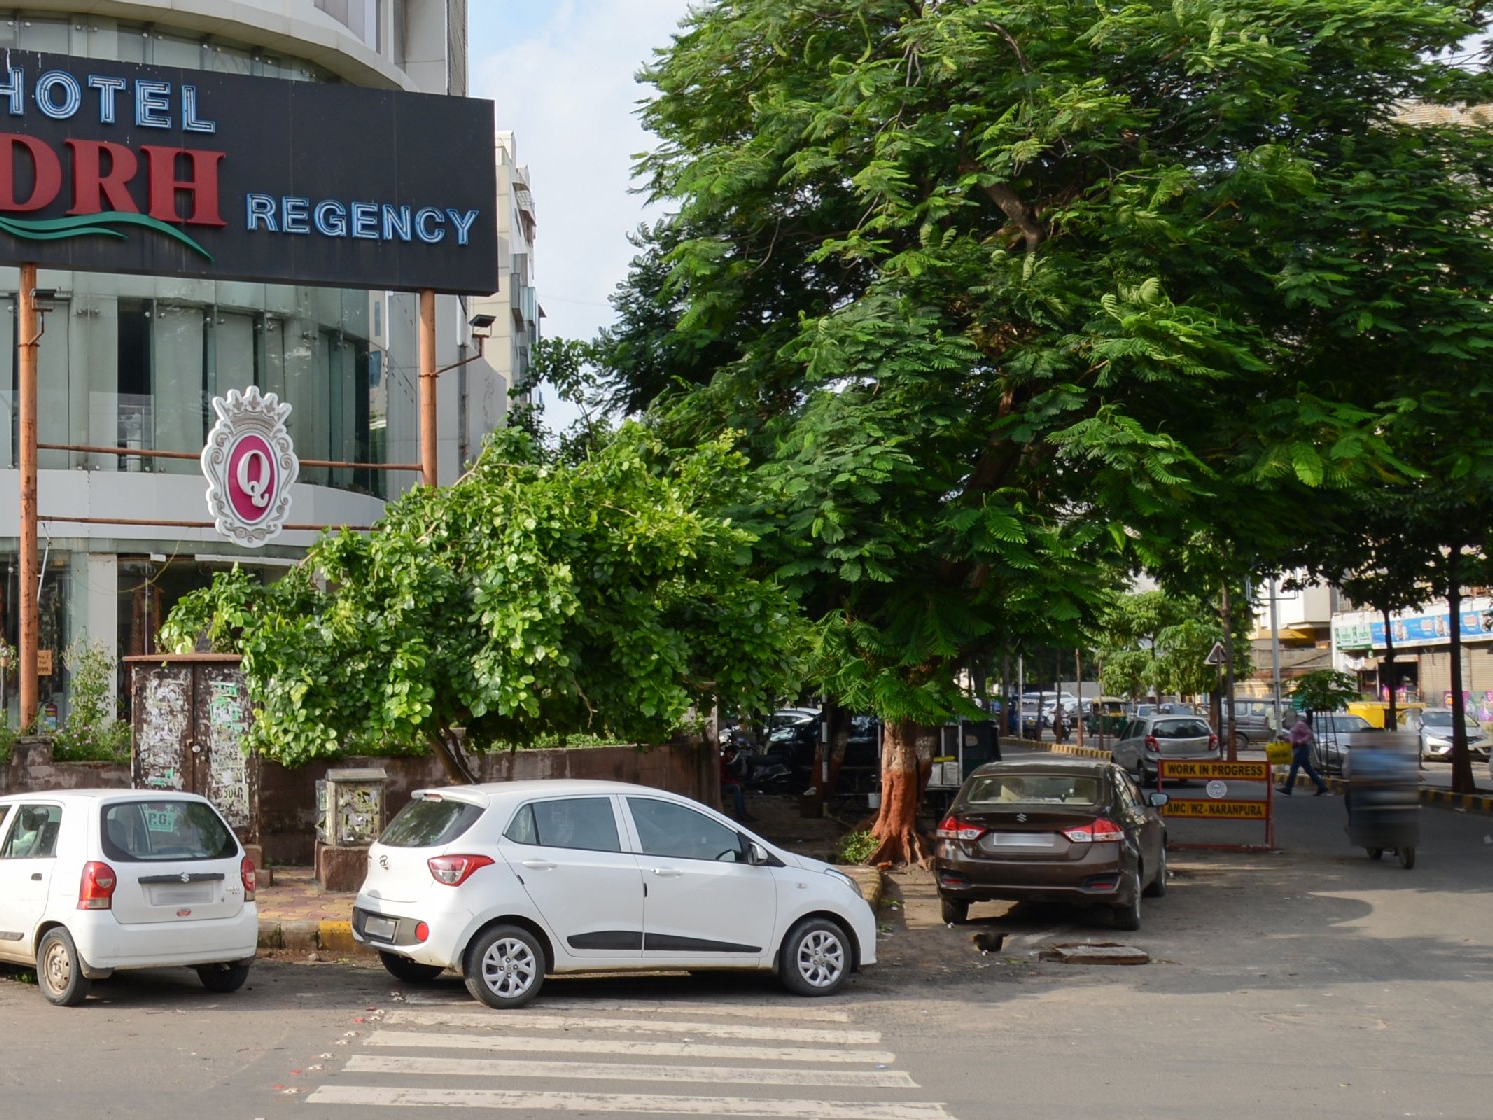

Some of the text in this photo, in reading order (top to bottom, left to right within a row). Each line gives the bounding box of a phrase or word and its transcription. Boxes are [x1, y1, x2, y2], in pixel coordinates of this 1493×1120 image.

[246, 193, 480, 246] REGENCY
[237, 450, 271, 508] Q
[1168, 764, 1264, 776] WORK IN PROGRESS
[1168, 802, 1186, 814] AMC
